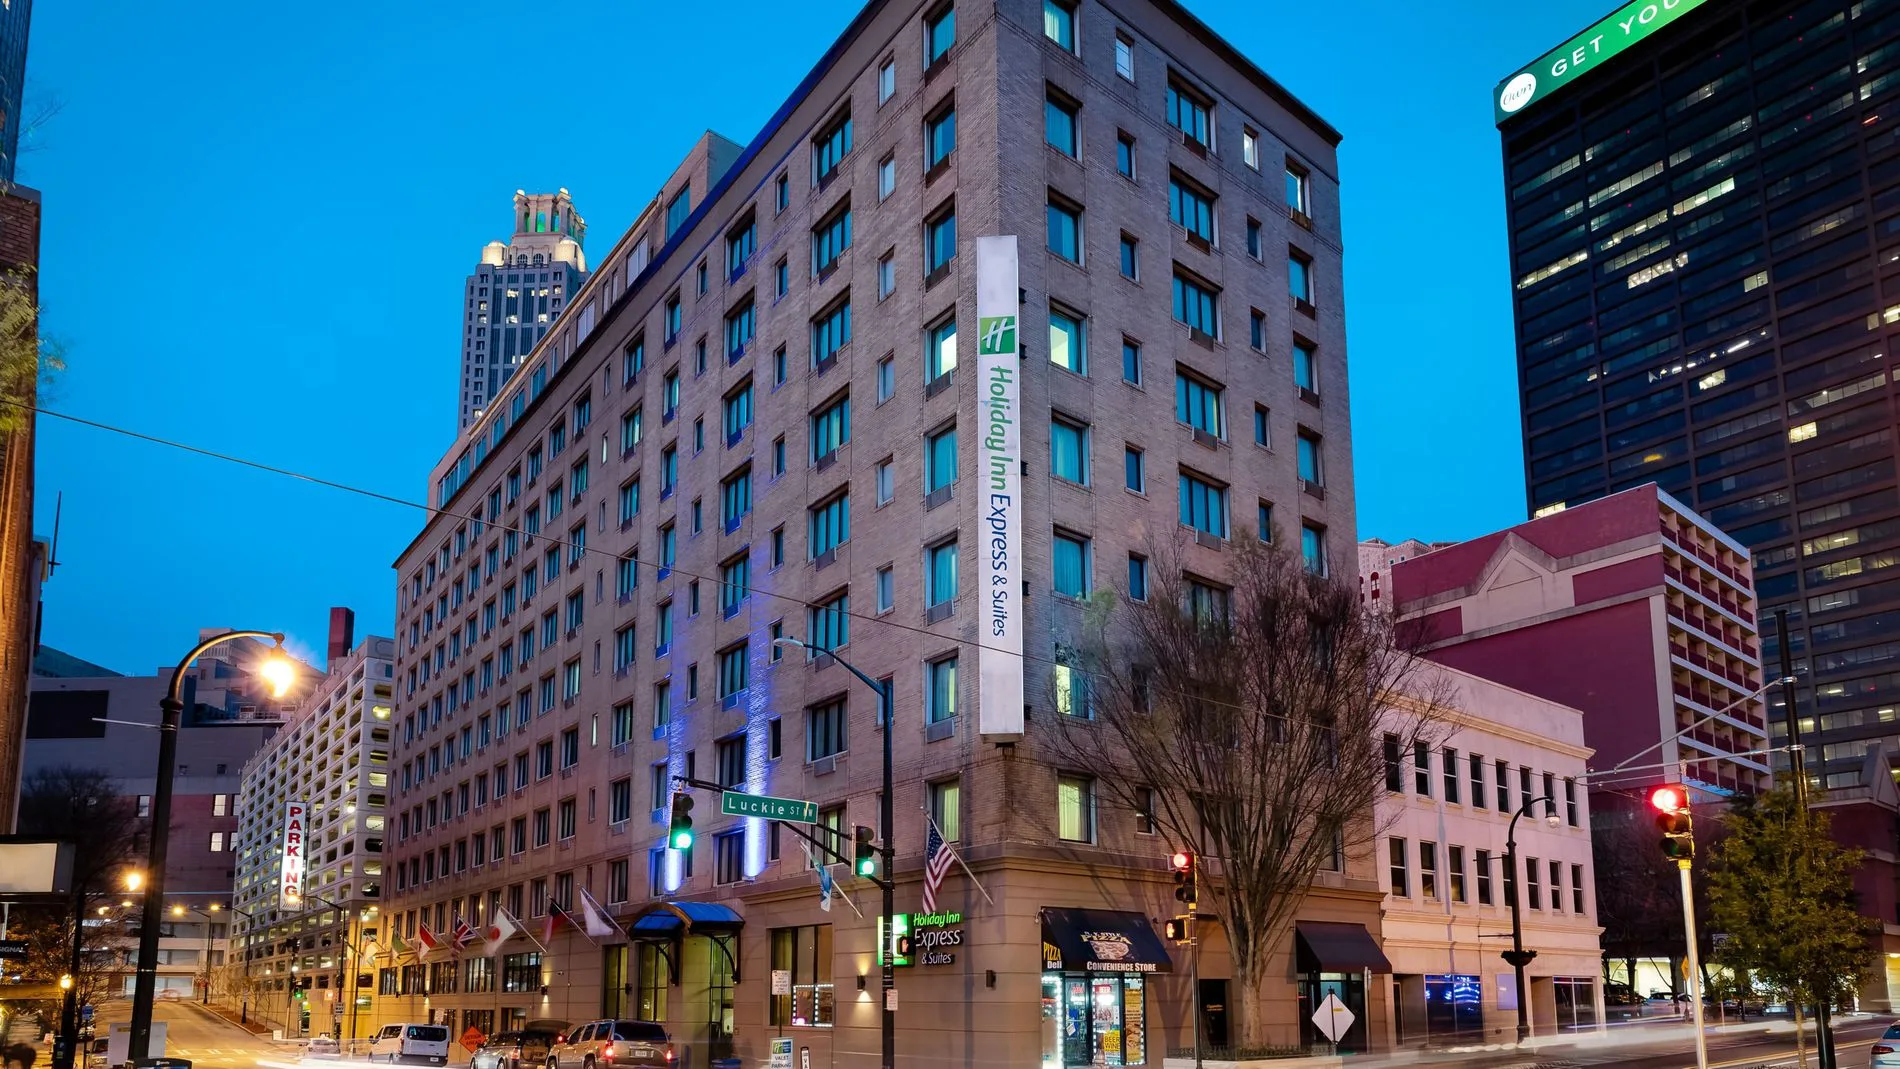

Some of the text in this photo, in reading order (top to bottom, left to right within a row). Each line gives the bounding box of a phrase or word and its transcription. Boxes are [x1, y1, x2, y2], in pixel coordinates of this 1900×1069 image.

[1551, 35, 1604, 77] GET
[985, 365, 1013, 637] Holiday Inn Express & Suites
[728, 797, 785, 815] Luckie
[789, 806, 800, 816] ST
[284, 806, 303, 897] PARKING
[913, 910, 960, 927] Holiday Inn
[914, 928, 961, 951] Express
[1081, 934, 1133, 945] PIZZA
[928, 952, 952, 964] Suites
[1043, 941, 1062, 961] PIZZA
[1047, 961, 1062, 969] Deli
[1087, 961, 1156, 972] CONVENIENCE STORE
